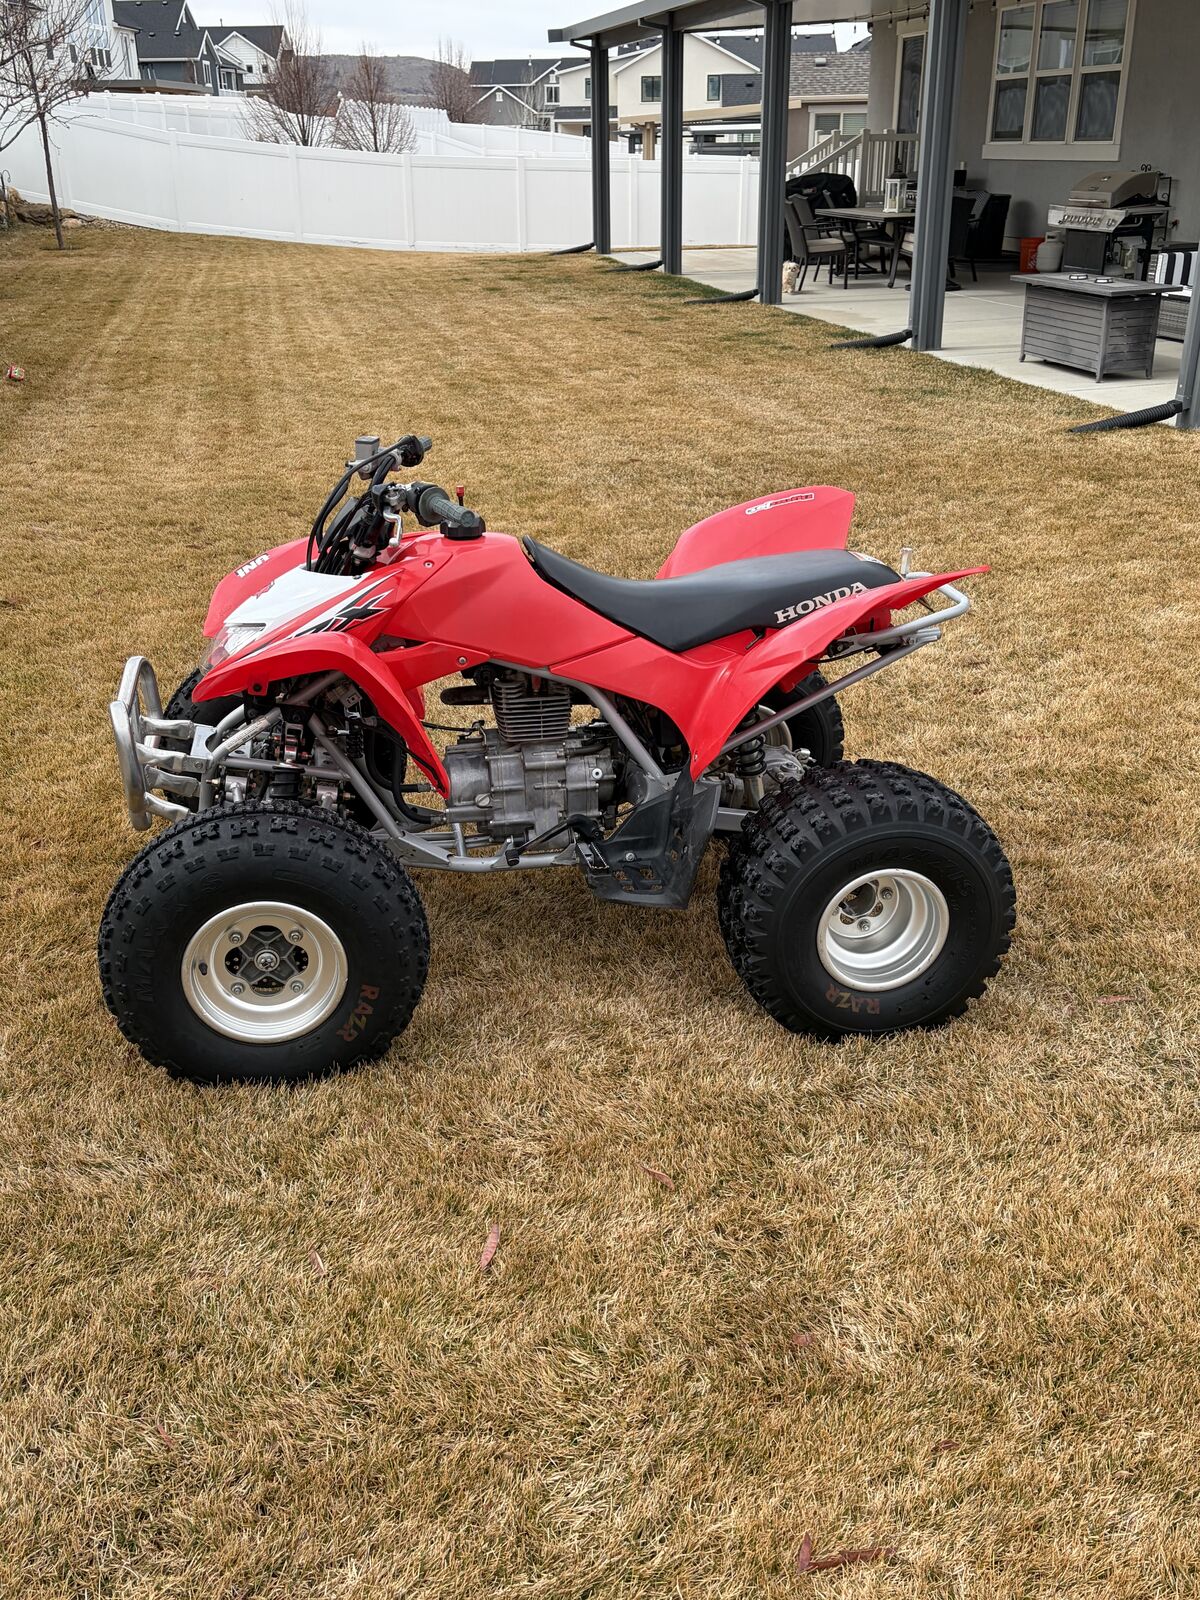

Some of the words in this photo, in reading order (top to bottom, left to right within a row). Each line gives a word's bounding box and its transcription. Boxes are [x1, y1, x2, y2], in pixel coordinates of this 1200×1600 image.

[774, 582, 869, 624] HONDA
[336, 983, 380, 1042] RAZR
[825, 983, 881, 1015] RAZR
